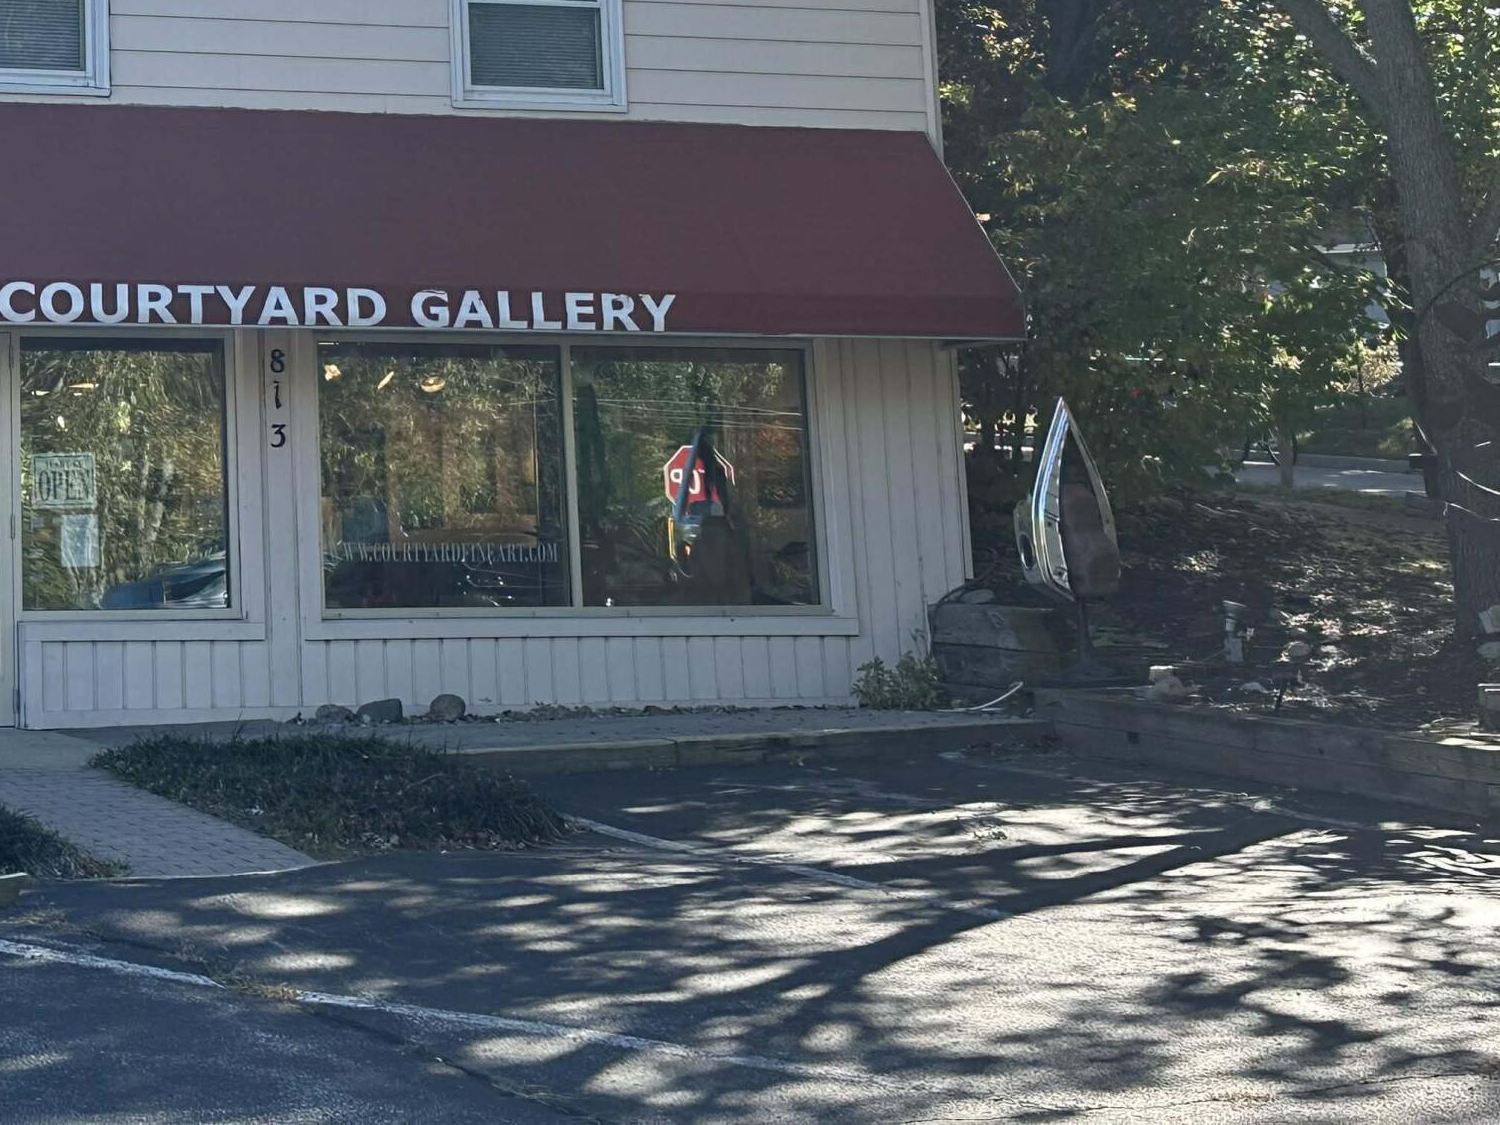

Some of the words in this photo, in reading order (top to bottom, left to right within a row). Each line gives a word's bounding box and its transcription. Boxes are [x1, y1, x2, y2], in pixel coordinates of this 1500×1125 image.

[411, 289, 676, 332] GALLERY
[270, 348, 287, 449] 813
[39, 470, 90, 502] OPEN
